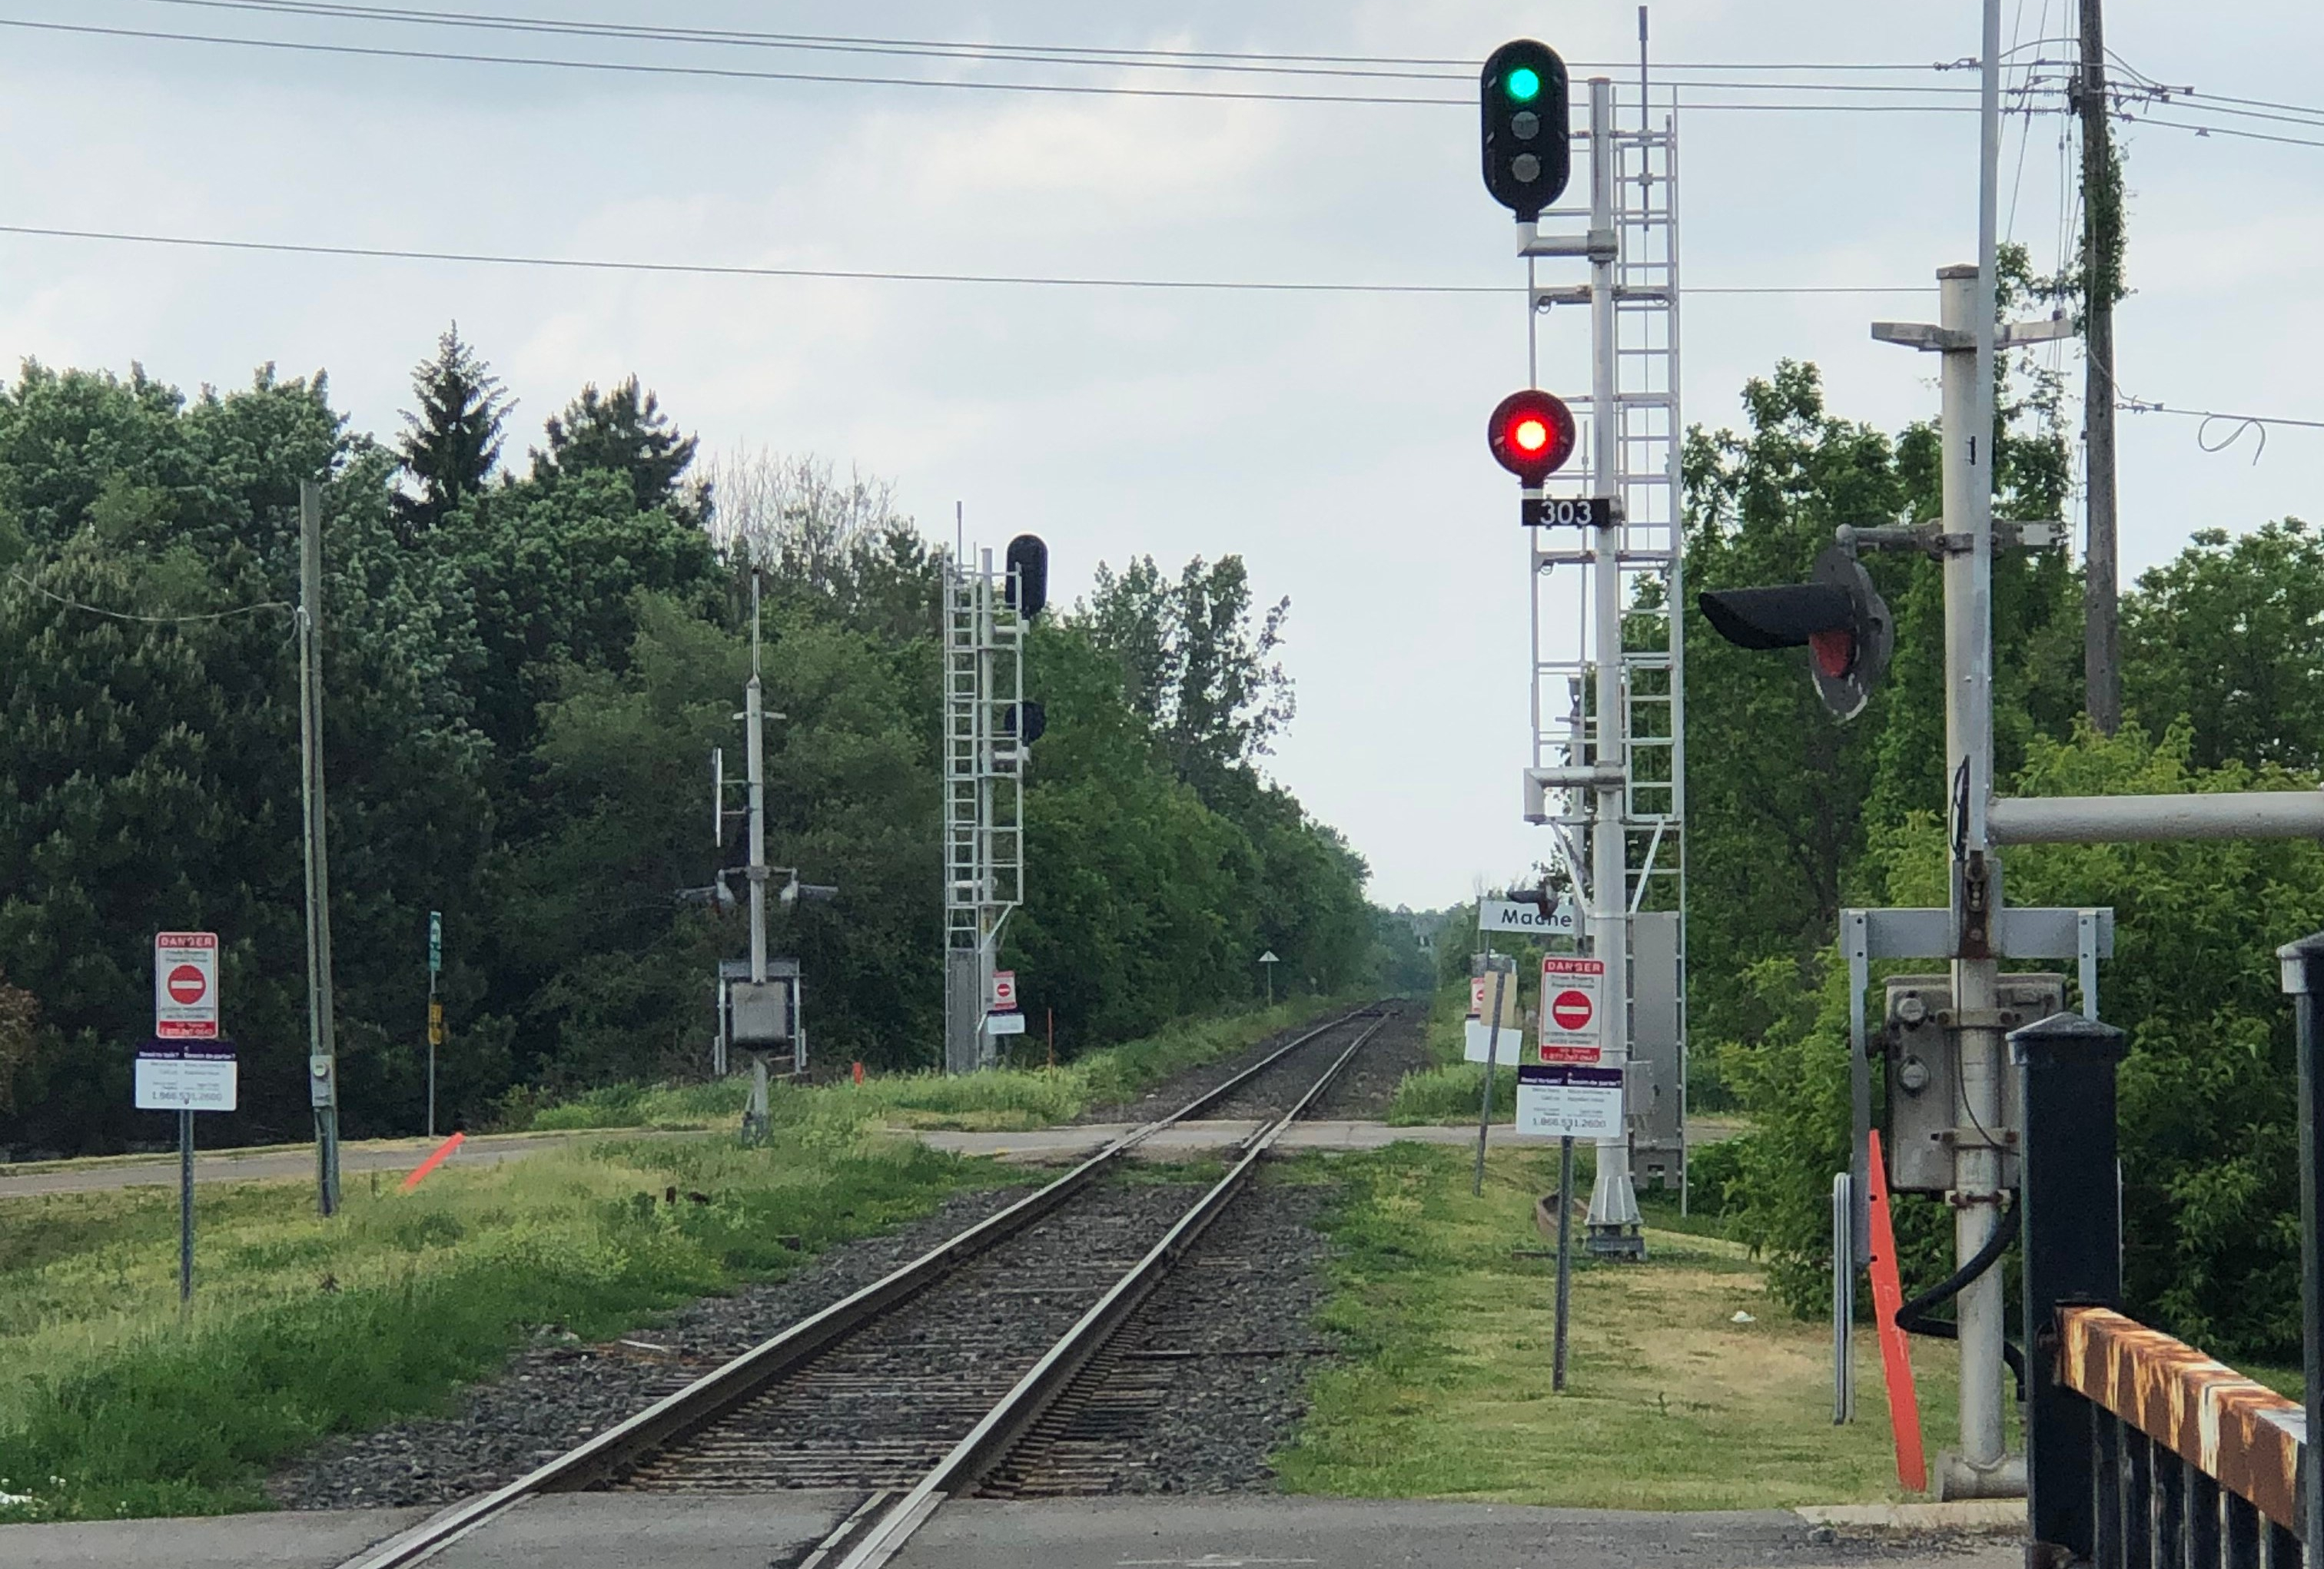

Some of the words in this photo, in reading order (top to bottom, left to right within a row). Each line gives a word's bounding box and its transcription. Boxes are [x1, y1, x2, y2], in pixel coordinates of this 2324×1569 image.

[1540, 500, 1592, 525] 303
[161, 937, 211, 947] DANGER
[1547, 961, 1601, 973] DANGER
